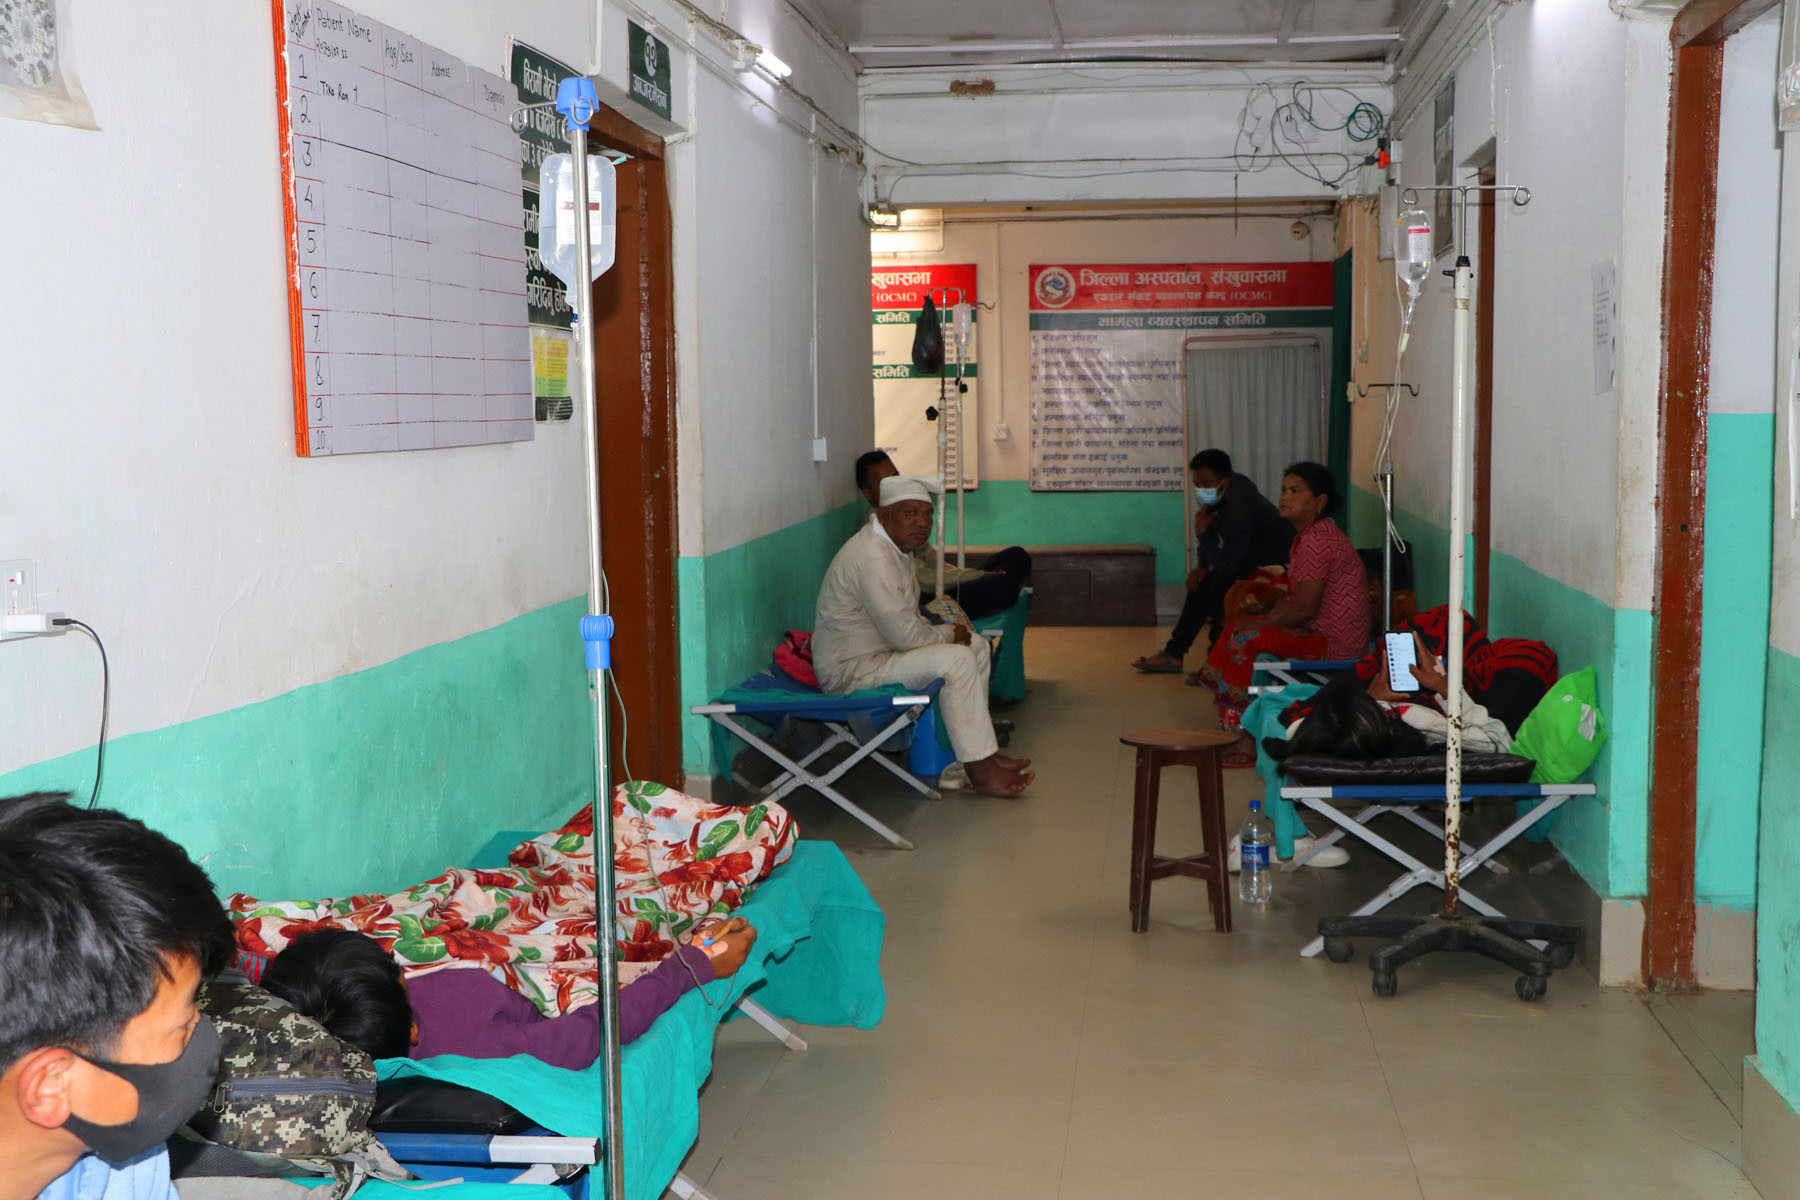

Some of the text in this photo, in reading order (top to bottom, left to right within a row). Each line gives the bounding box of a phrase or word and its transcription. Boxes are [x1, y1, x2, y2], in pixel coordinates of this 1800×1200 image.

[316, 8, 372, 43] Patient Name
[298, 54, 308, 79] 1
[385, 40, 414, 69] Age/Sex
[300, 95, 312, 123] 2
[302, 141, 312, 167] 3
[304, 185, 313, 210] 4
[306, 229, 317, 254] 5
[309, 271, 319, 299] 6
[1080, 268, 1129, 287] जिल्ला
[1210, 267, 1287, 288] संखुवासभा
[876, 292, 917, 303] (OCMC)
[1230, 290, 1272, 302] (OCMC)
[311, 314, 321, 343] 7
[875, 311, 911, 323] समिति
[1098, 312, 1267, 328] मामला व्यवस्थापन समिति
[315, 355, 325, 386] 8
[872, 365, 910, 378] समिति
[315, 398, 324, 421] 9
[314, 430, 326, 451] 10
